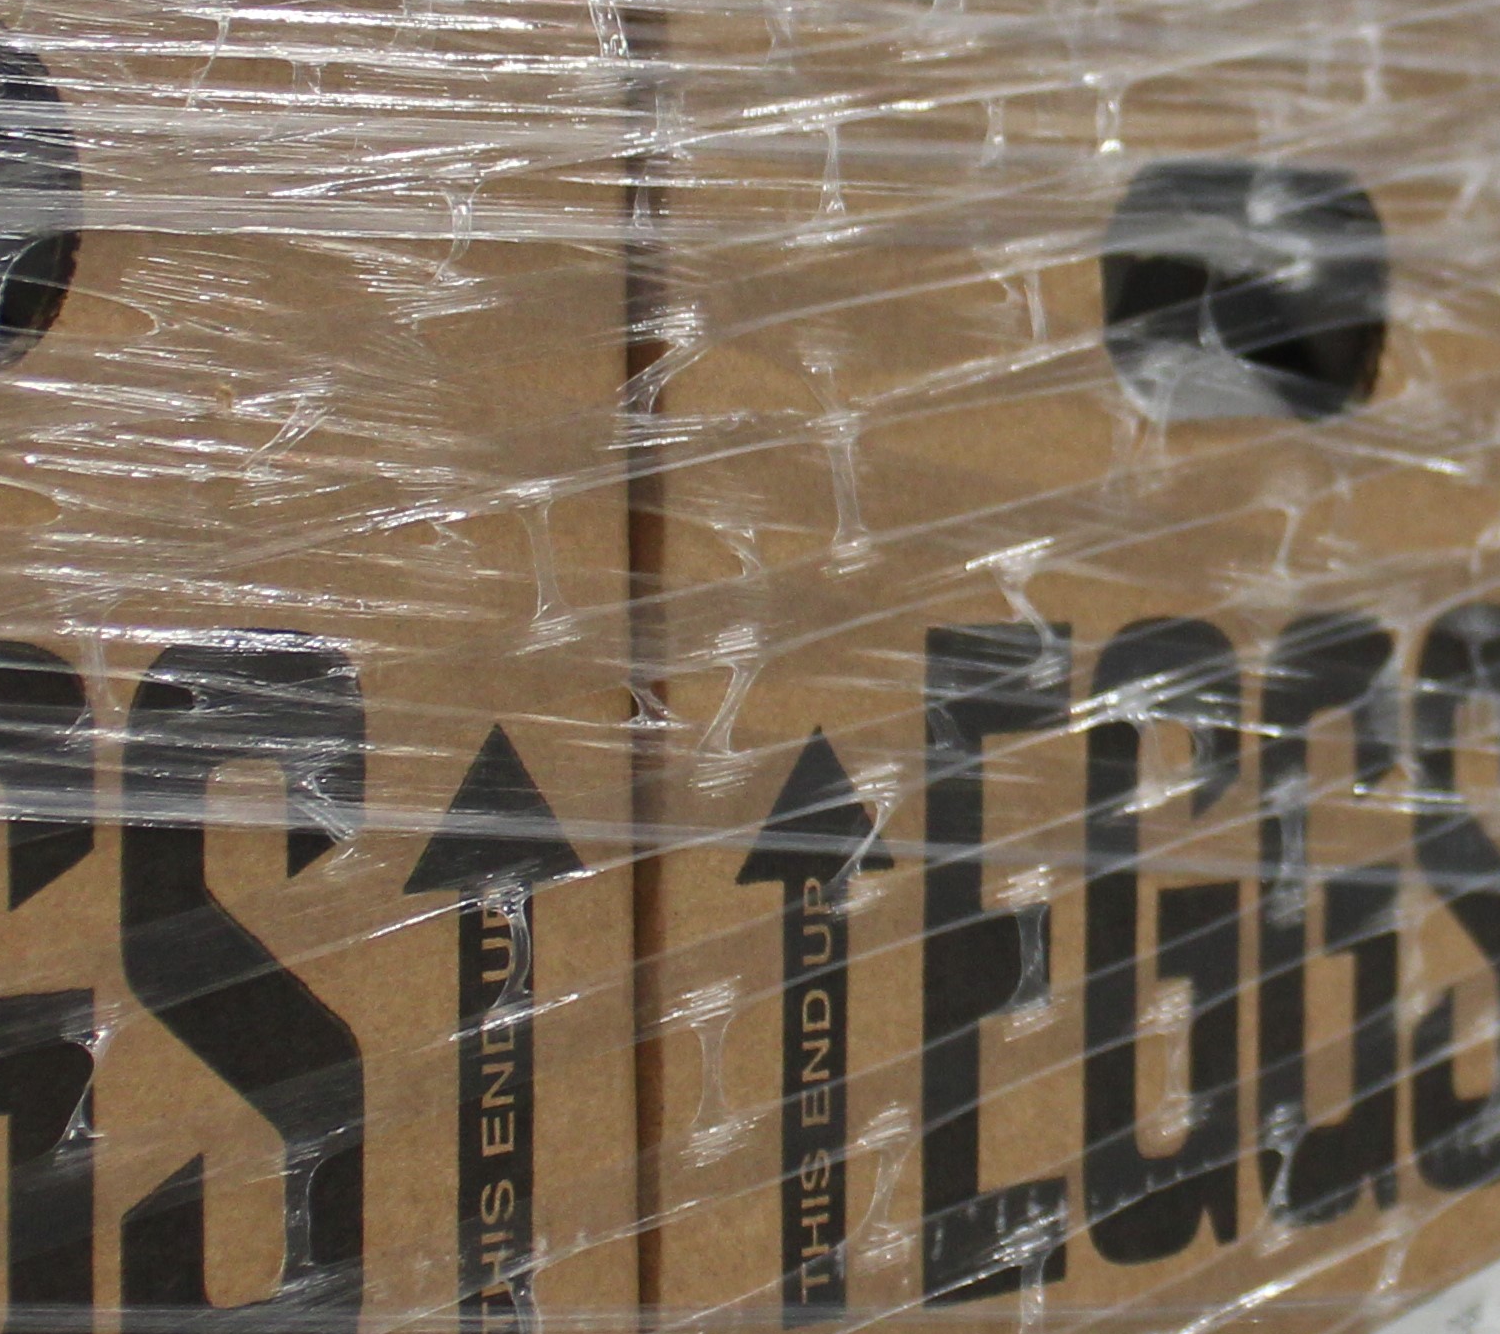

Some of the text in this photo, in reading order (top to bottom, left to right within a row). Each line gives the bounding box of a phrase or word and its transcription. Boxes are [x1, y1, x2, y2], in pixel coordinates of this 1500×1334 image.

[480, 1010, 516, 1158] END
[801, 875, 831, 1304] THIS END UP
